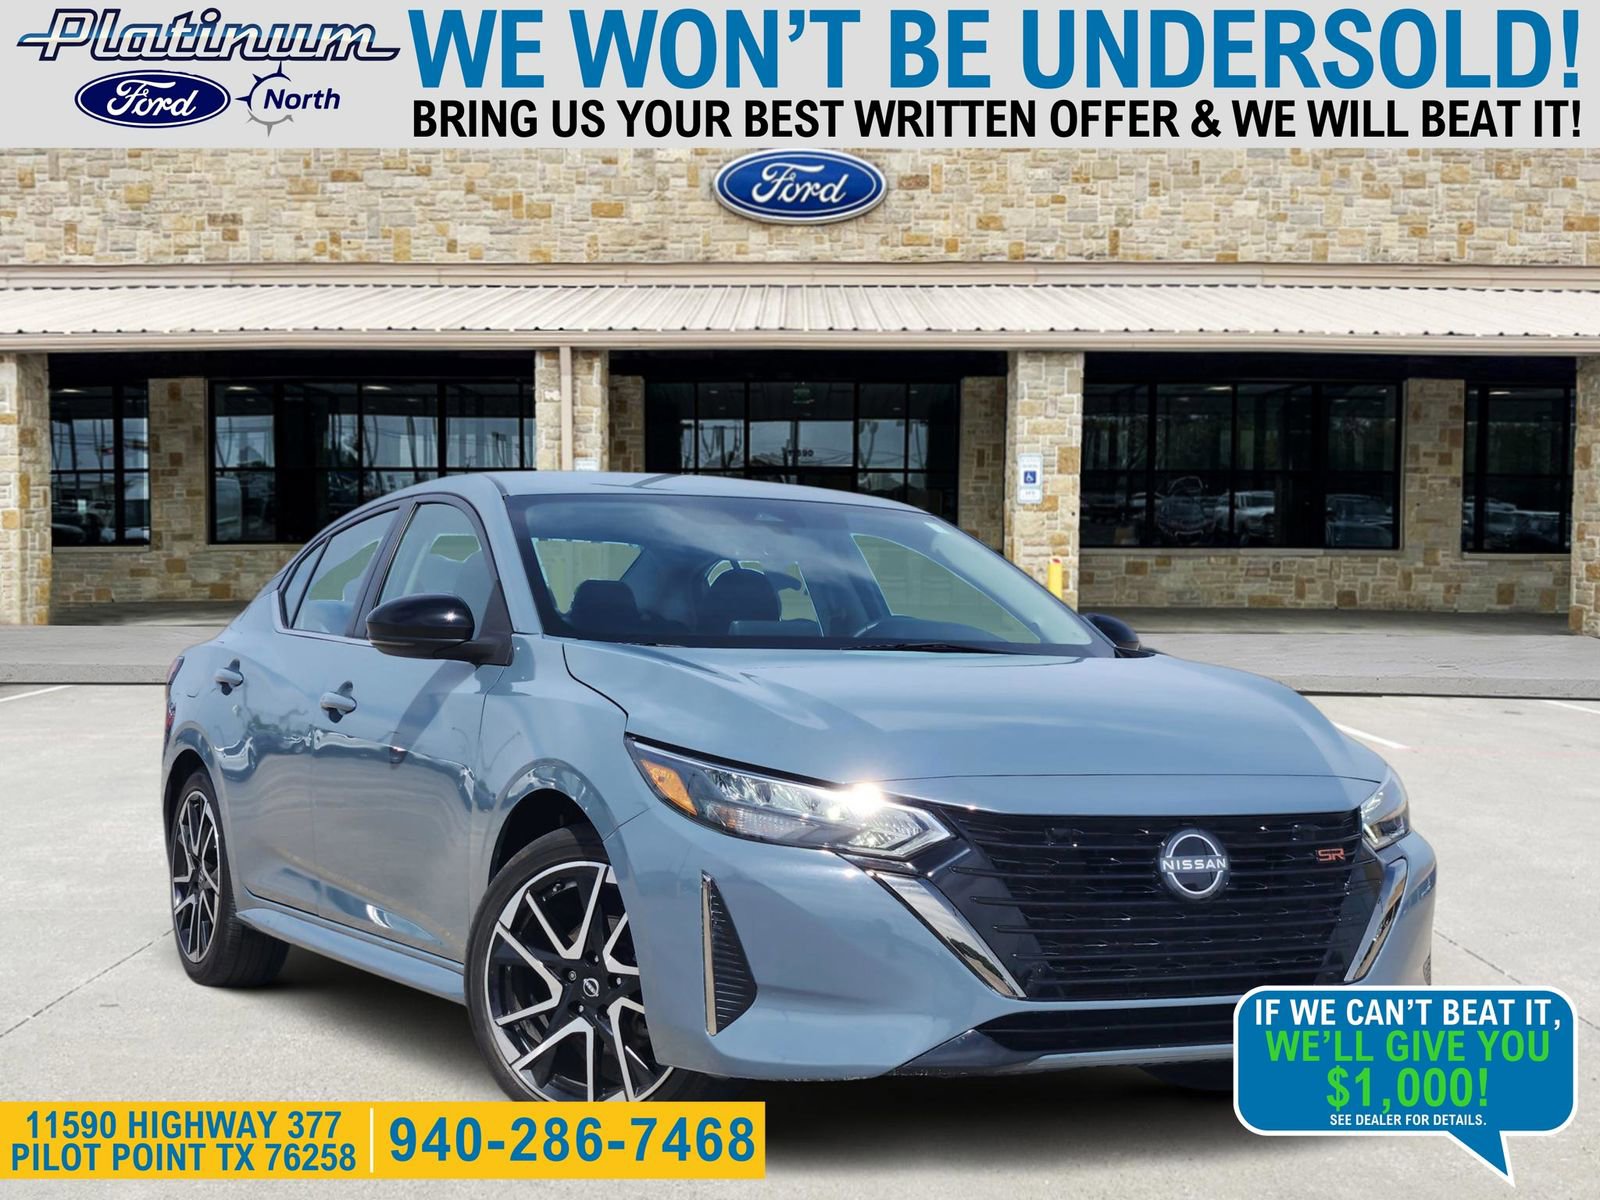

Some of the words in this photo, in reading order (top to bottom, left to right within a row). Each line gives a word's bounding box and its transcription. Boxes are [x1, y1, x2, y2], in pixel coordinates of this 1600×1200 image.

[751, 162, 849, 203] Ford
[1317, 848, 1346, 862] SR
[1162, 858, 1226, 871] NISSAN
